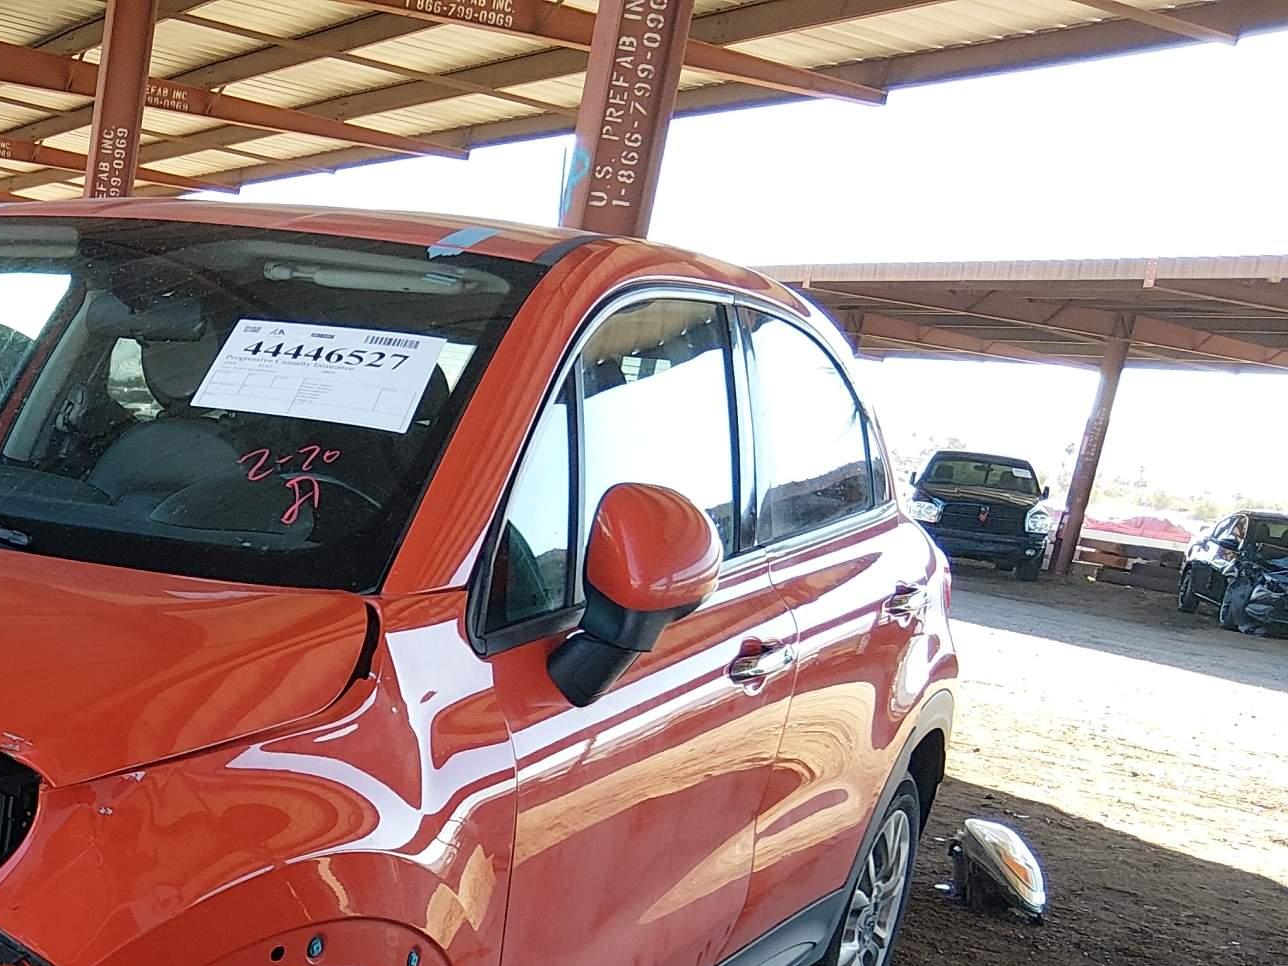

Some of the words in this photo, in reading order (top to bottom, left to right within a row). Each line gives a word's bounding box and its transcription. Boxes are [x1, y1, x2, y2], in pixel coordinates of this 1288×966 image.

[601, 35, 638, 141] PREFAB
[589, 157, 617, 208] U.S.
[242, 340, 411, 371] 44446527
